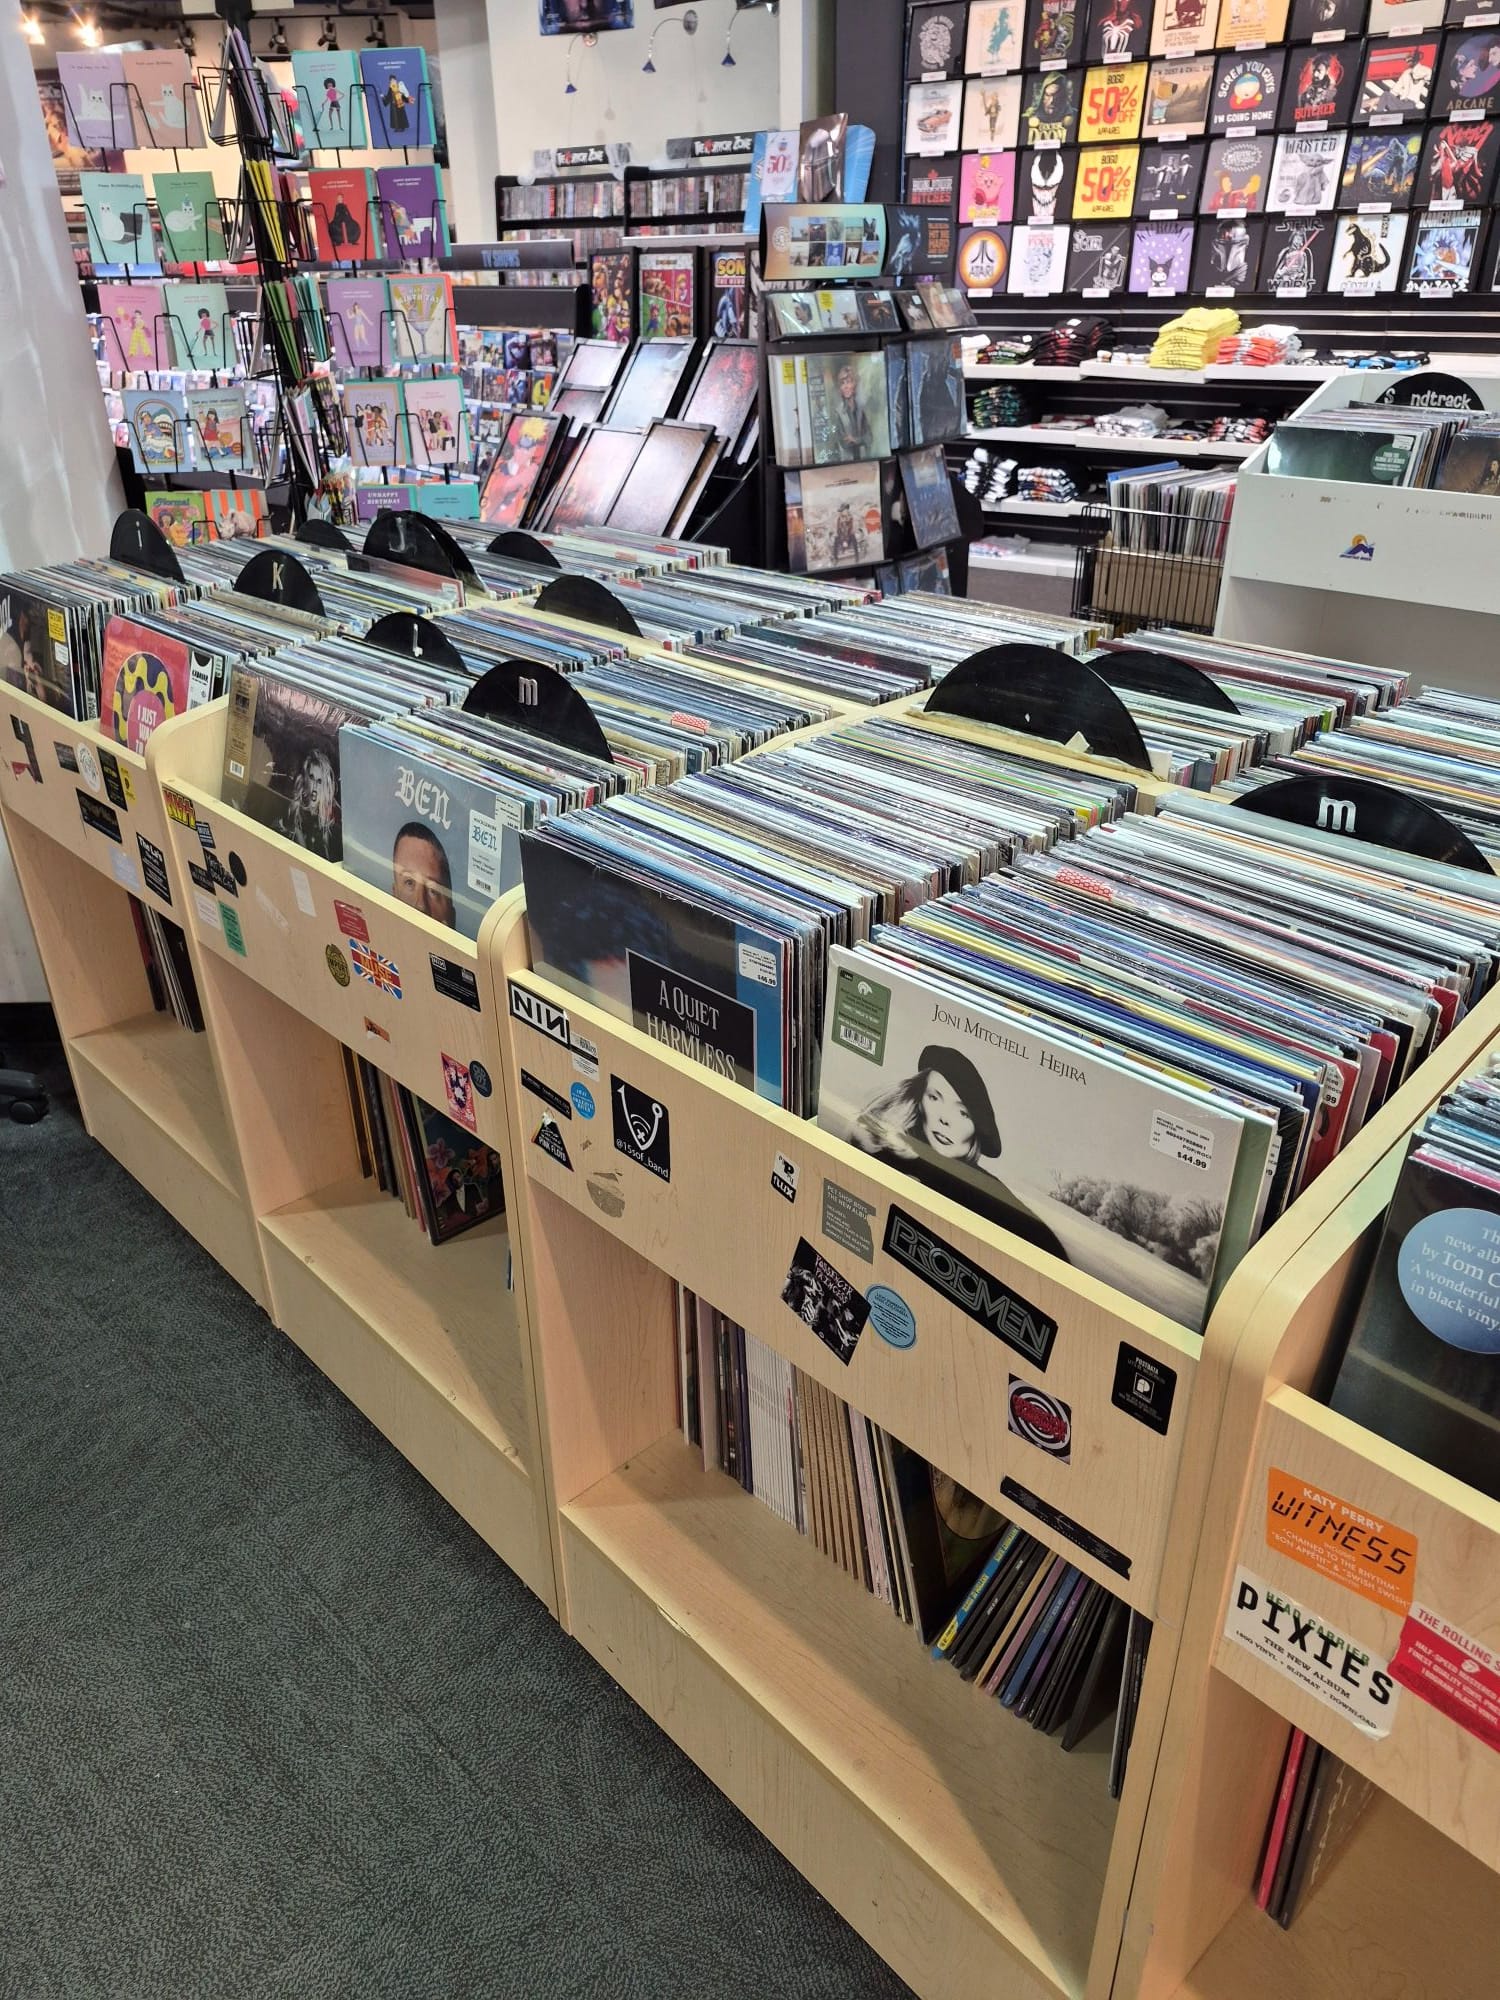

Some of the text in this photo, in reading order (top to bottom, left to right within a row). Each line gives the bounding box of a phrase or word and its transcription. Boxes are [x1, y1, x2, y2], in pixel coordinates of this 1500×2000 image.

[1218, 60, 1276, 98] SCREW YOU GUYS
[1087, 85, 1138, 126] 50%
[1214, 110, 1273, 124] I'M GOING HOME
[1294, 102, 1336, 119] BUTCHER
[1447, 97, 1494, 111] ARCANE
[1028, 128, 1067, 146] DOOM
[1284, 137, 1337, 154] WANTED
[1082, 165, 1131, 203] 50%
[272, 561, 285, 591] K
[518, 676, 539, 706] m
[142, 706, 157, 726] JUST
[395, 766, 452, 830] BEN
[1318, 796, 1357, 834] m
[360, 954, 393, 980] MUSE
[659, 979, 720, 1030] A QUIET
[685, 1019, 700, 1037] AND
[646, 1012, 736, 1083] HARMLESS
[932, 1004, 1087, 1086] JONI MITCHELL HEJIRA
[539, 1135, 567, 1162] PINK FLOYD
[1177, 1151, 1207, 1169] $44.99
[839, 1191, 852, 1204] SHOP
[853, 1200, 868, 1213] BOYS
[839, 1198, 851, 1211] NEW
[1445, 1234, 1500, 1264] new alb
[1481, 1227, 1500, 1246] Th
[1422, 1242, 1440, 1261] by
[1443, 1250, 1485, 1281] Tom
[1426, 1269, 1500, 1309] wonderful
[1410, 1279, 1500, 1332] in black viny
[1303, 1487, 1384, 1533] KATY PERRY
[1271, 1490, 1413, 1575] WITNESS
[1326, 1550, 1338, 1561] TO
[1341, 1558, 1357, 1570] THE
[1236, 1580, 1394, 1706] PIXIES
[1266, 1591, 1370, 1667] HEAD CARRIER
[1418, 1608, 1441, 1630] THE
[1441, 1624, 1493, 1664] ROLLING
[1264, 1636, 1351, 1700] THE NEW ALBUM
[1432, 1663, 1462, 1687] QUALITY
[1254, 1641, 1278, 1661] VINYL
[1286, 1664, 1321, 1690] SLIPMAT
[1329, 1693, 1377, 1729] DOWNLOAD
[1454, 1690, 1478, 1711] BLACK
